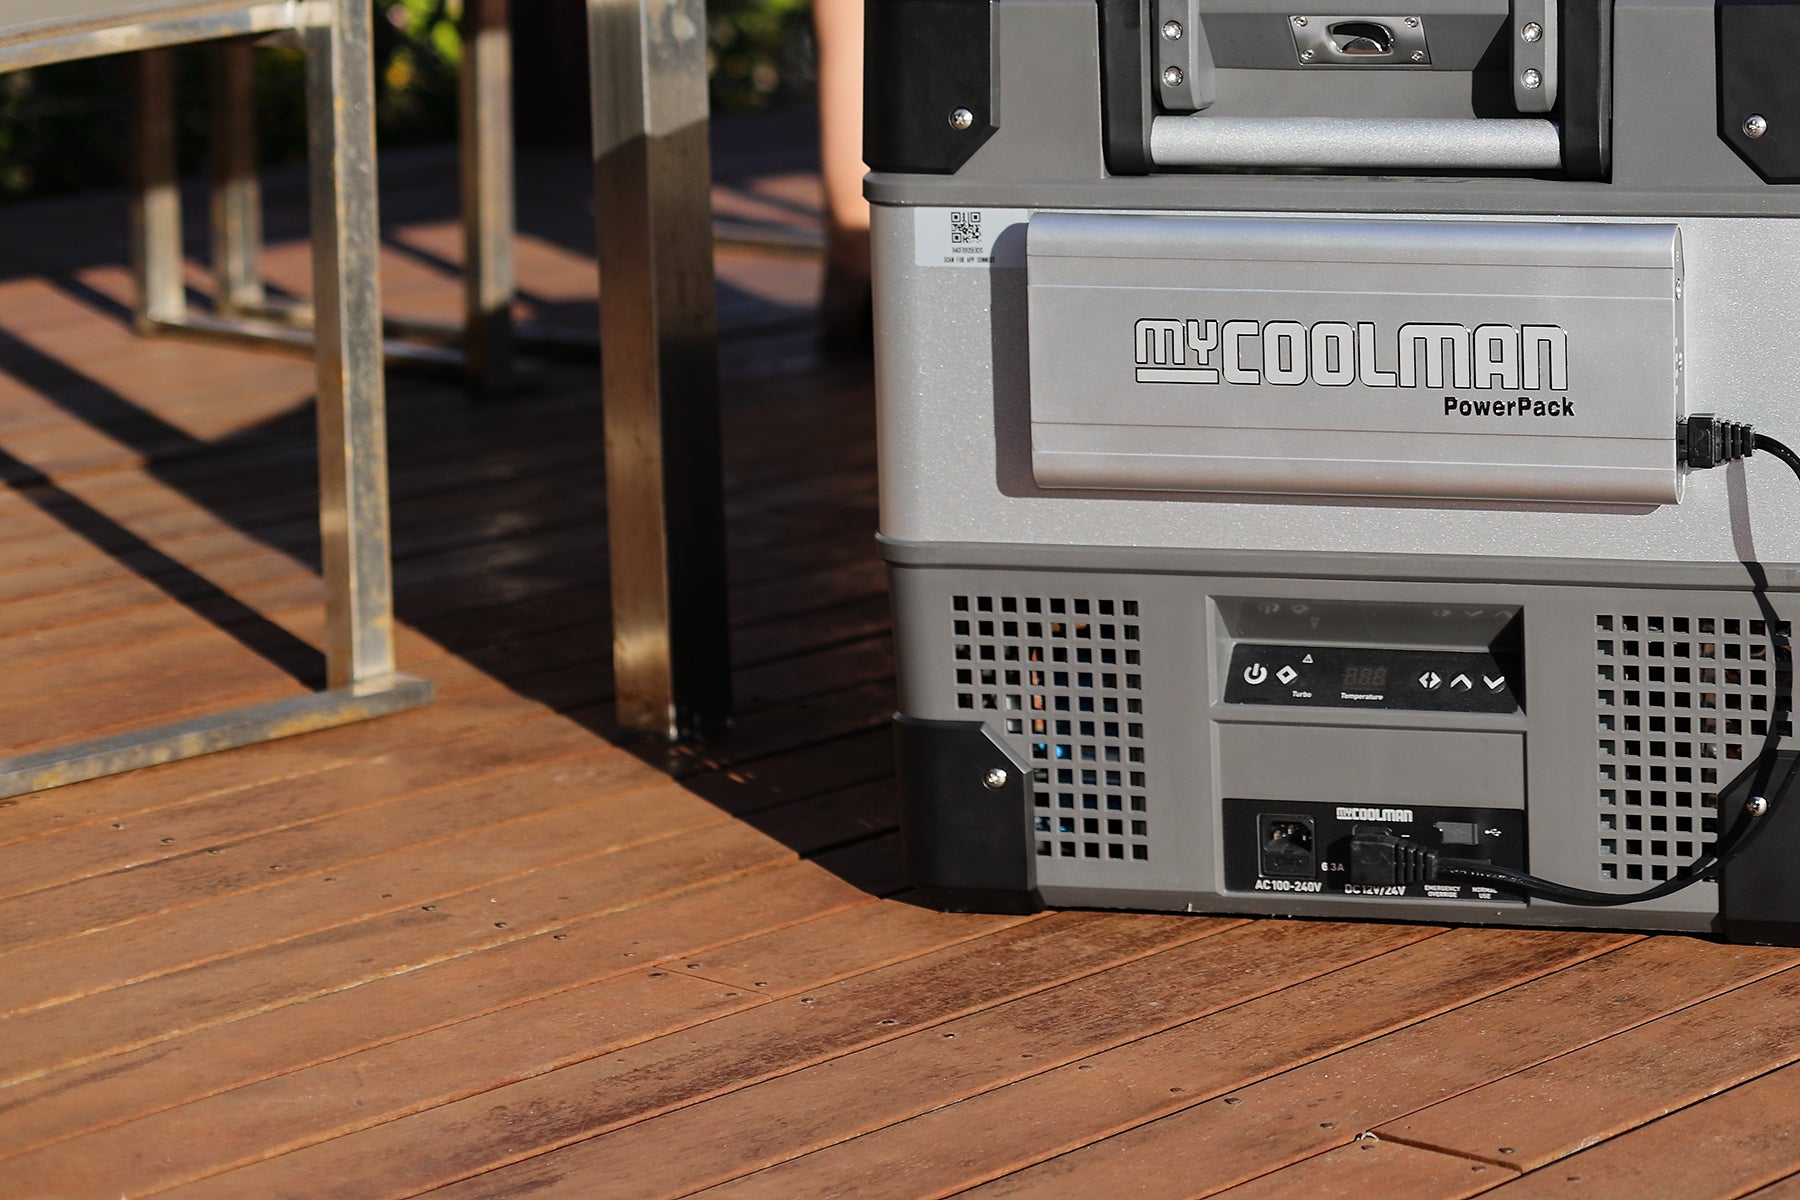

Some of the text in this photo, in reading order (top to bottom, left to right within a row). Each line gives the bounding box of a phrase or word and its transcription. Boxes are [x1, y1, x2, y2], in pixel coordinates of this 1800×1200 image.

[1134, 317, 1569, 391] MYCOOLMAN
[1444, 396, 1575, 417] PowerPack
[1292, 690, 1312, 698] Turbo
[1340, 692, 1384, 701] Temperature
[1336, 807, 1414, 822] MYCOOLMAN
